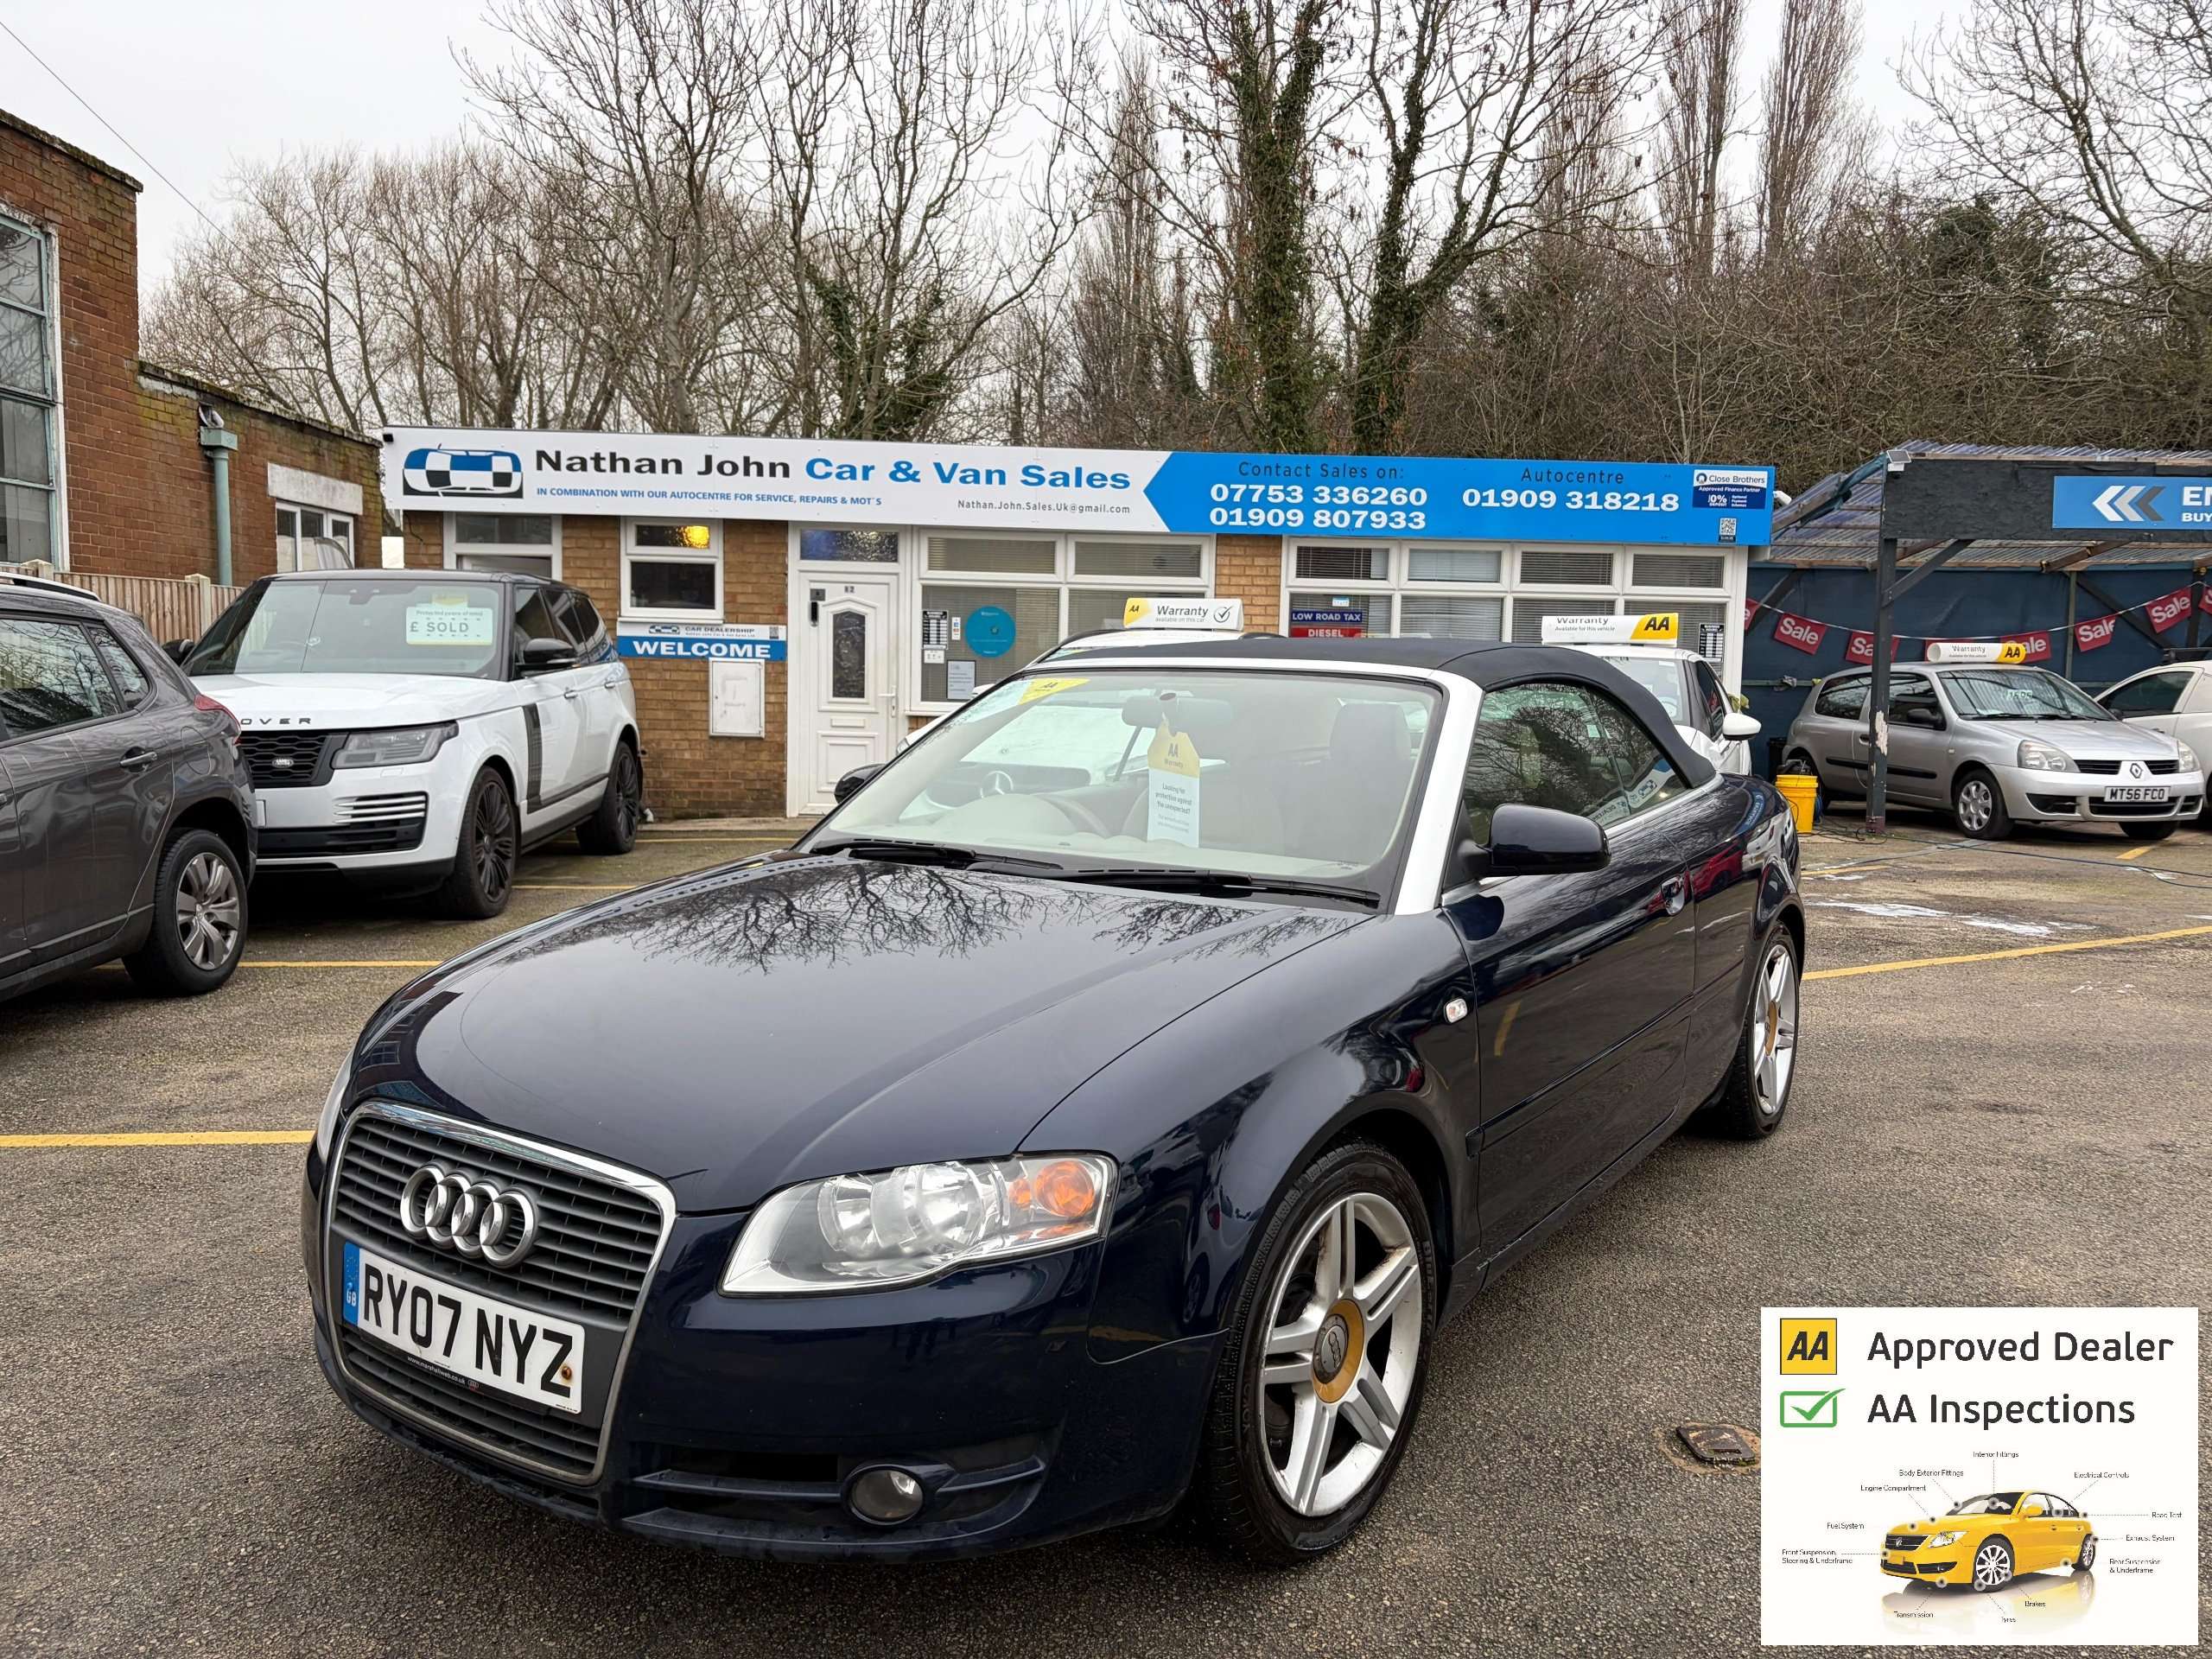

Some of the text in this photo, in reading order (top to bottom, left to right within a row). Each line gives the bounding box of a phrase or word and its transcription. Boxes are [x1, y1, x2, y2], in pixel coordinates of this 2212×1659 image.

[536, 449, 1131, 489] Nathan John Car & Van Sales
[1238, 461, 1404, 479] Contact Sales on:
[1521, 467, 1624, 484] Autocentre
[537, 487, 547, 496] IN
[550, 487, 618, 498] COMBINATION
[620, 489, 645, 499] WITH
[647, 491, 668, 499] OUR
[670, 492, 732, 500] AUTOCENTRE
[734, 493, 753, 501] FOR
[755, 493, 797, 504] SERVICE,
[799, 495, 838, 505] REPAIRS
[1211, 483, 1427, 505] 07753 336260
[1462, 488, 1680, 512] 01909 318218
[957, 499, 1130, 514] Nathan.John.Sales.Uk@gmail.com
[1210, 507, 1426, 530] 01909 807933
[2182, 512, 2212, 522] BUY
[1157, 606, 1208, 618] Warranty
[1315, 613, 1341, 621] ROAD
[1344, 613, 1361, 621] TAX
[2151, 596, 2191, 623] Sale
[410, 621, 469, 632] £ SOLD
[1557, 617, 1609, 626] Warranty
[1644, 616, 1669, 631] AA
[1307, 629, 1344, 638] DIESEL
[1780, 618, 1819, 645] Sale
[632, 641, 772, 658] WELCOME
[1851, 638, 1874, 657] Sa
[1951, 645, 1986, 654] Warranty
[2004, 647, 2021, 658] AA
[2006, 637, 2047, 654] ale
[1168, 742, 1179, 759] AA
[2110, 788, 2141, 800] MT56
[346, 1287, 357, 1307] GB
[364, 1263, 573, 1398] RY07 NYZ
